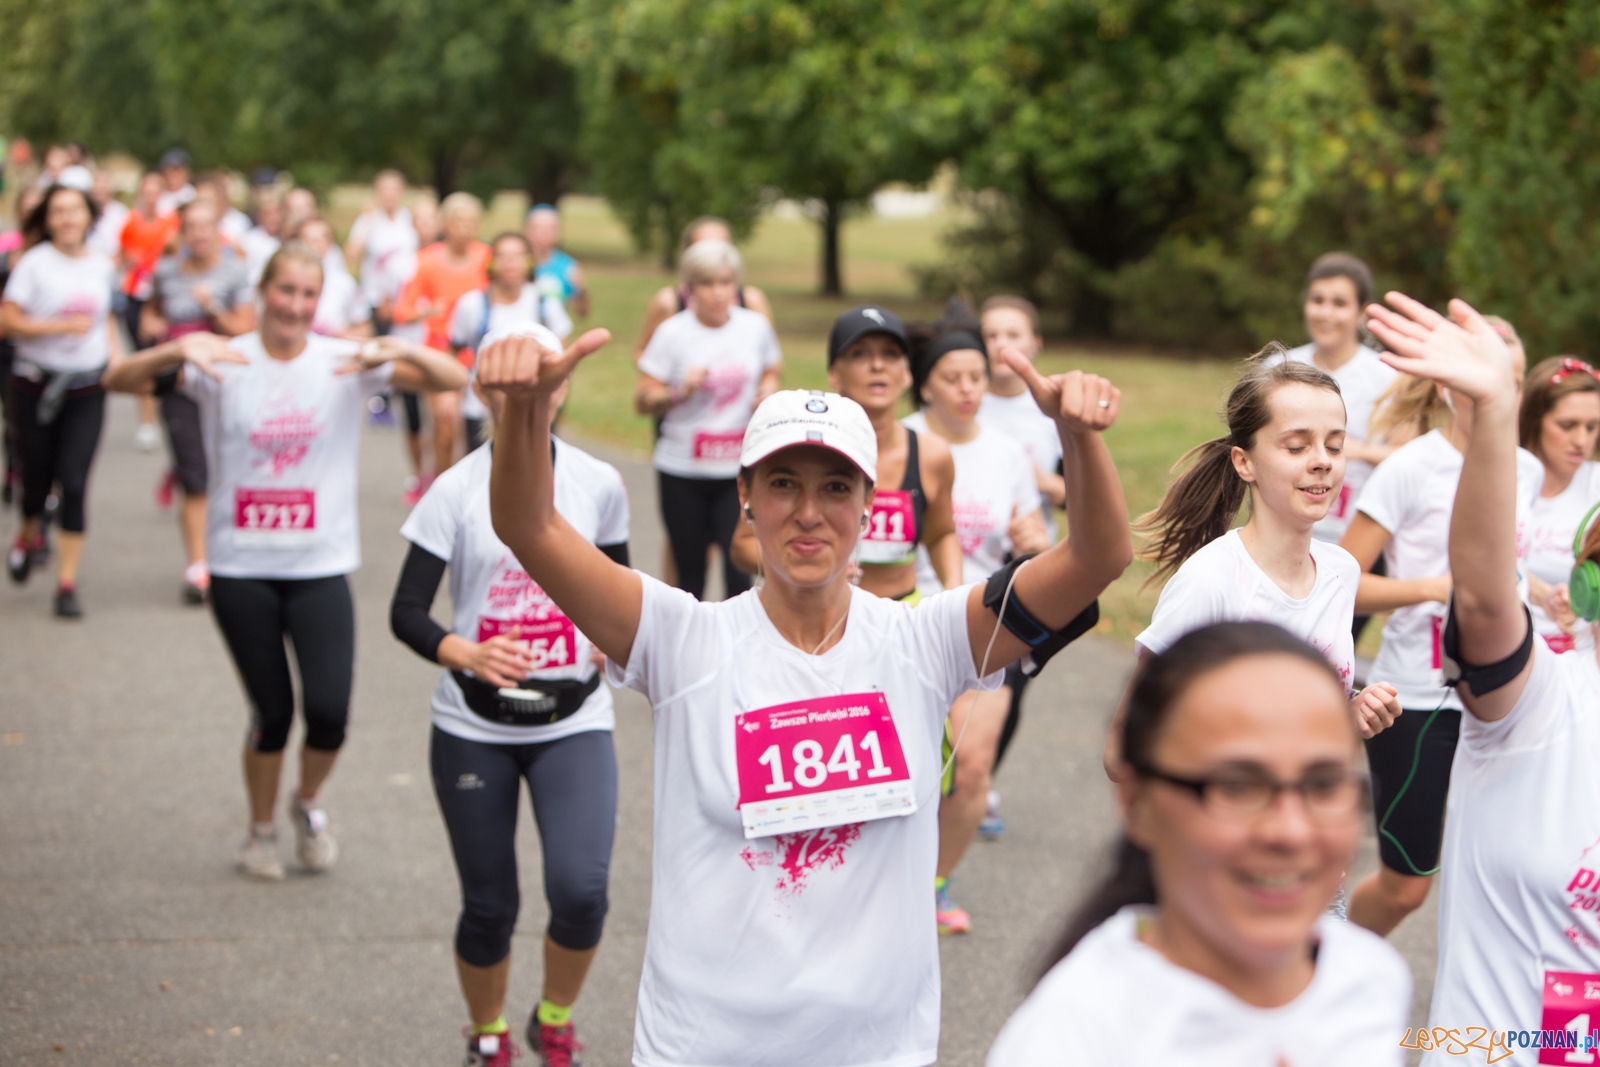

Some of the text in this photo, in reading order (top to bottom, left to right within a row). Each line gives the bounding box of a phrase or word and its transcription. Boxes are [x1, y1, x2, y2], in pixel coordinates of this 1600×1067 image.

[243, 503, 312, 529] 1717
[769, 718, 808, 730] Zawsze
[848, 705, 871, 717] 2016
[758, 730, 892, 793] 1841
